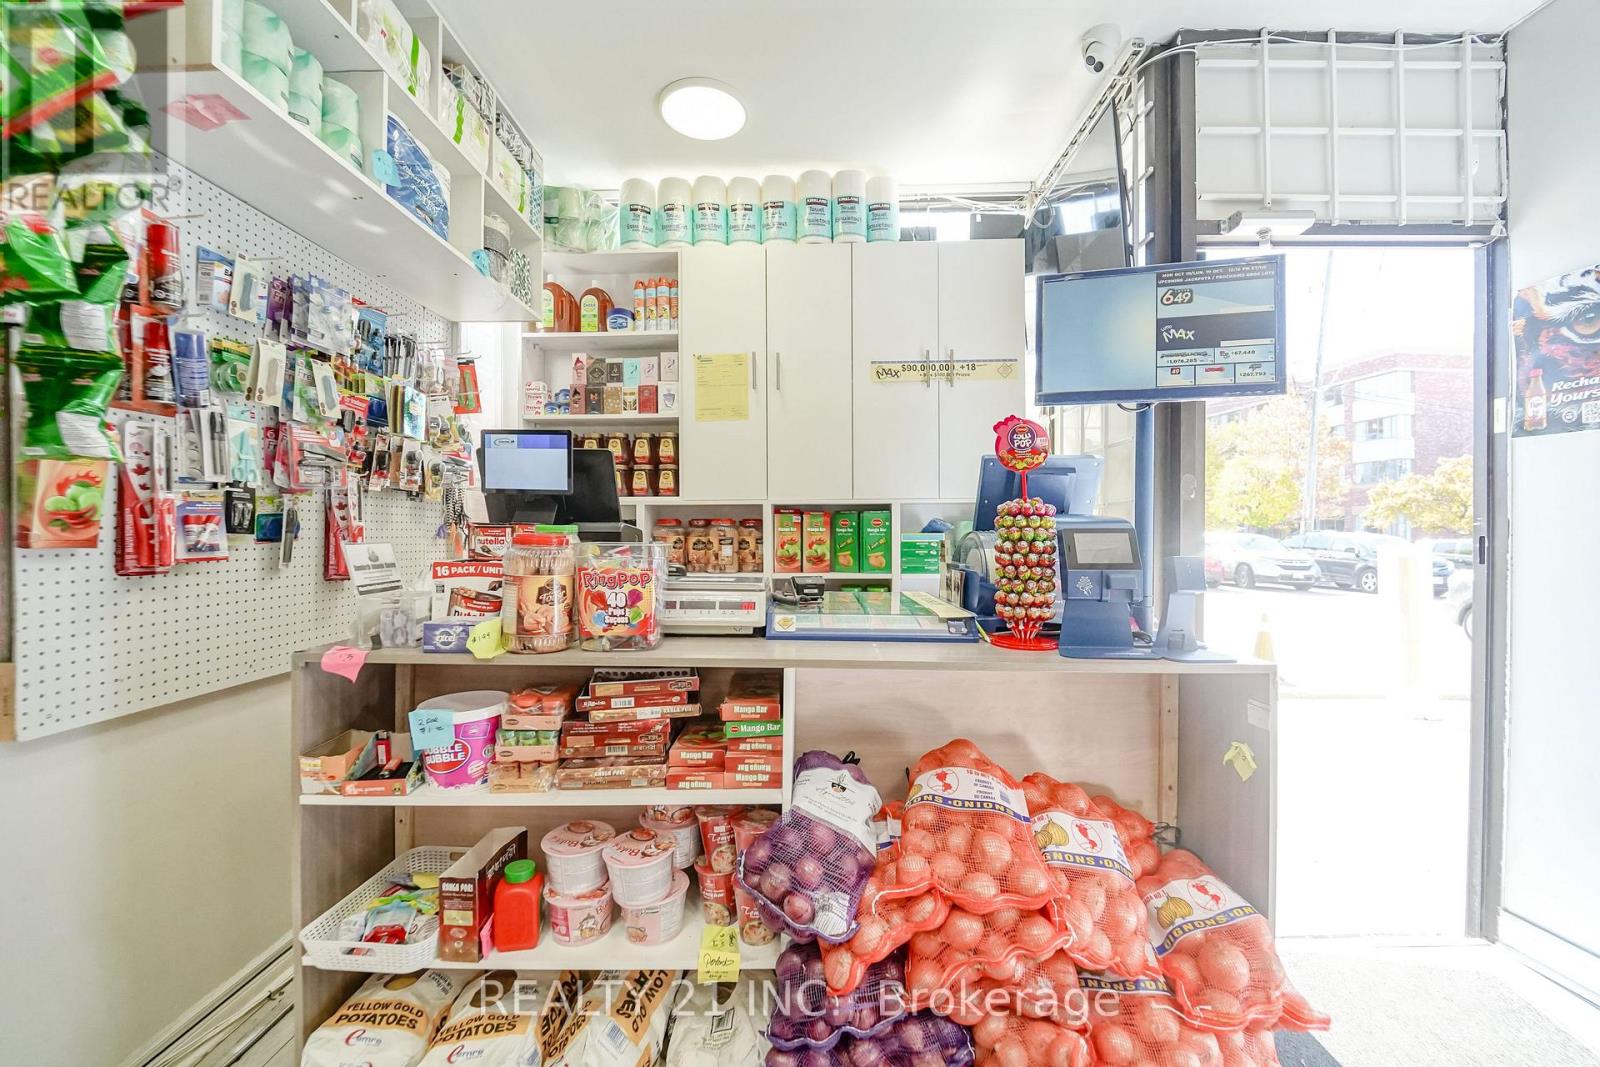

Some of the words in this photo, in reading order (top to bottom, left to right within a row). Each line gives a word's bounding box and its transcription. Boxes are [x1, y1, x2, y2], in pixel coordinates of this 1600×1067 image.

[1162, 328, 1195, 343] MAX
[1014, 439, 1032, 448] POP
[435, 566, 450, 577] 16
[451, 566, 476, 575] PACK
[607, 592, 627, 608] 40
[733, 705, 755, 714] Mango
[756, 705, 768, 713] Bar
[740, 724, 765, 733] Mango
[680, 751, 702, 760] Mango
[702, 751, 714, 759] Bar
[749, 763, 771, 772] Mango
[735, 773, 757, 782] Mango
[757, 773, 770, 781] Bar
[678, 781, 690, 789] Bar
[690, 781, 713, 789] Mango
[952, 799, 1016, 816] ONIONS
[346, 1002, 392, 1011] YELLOW
[393, 1002, 424, 1018] GOLD
[335, 1013, 418, 1029] POTATOES
